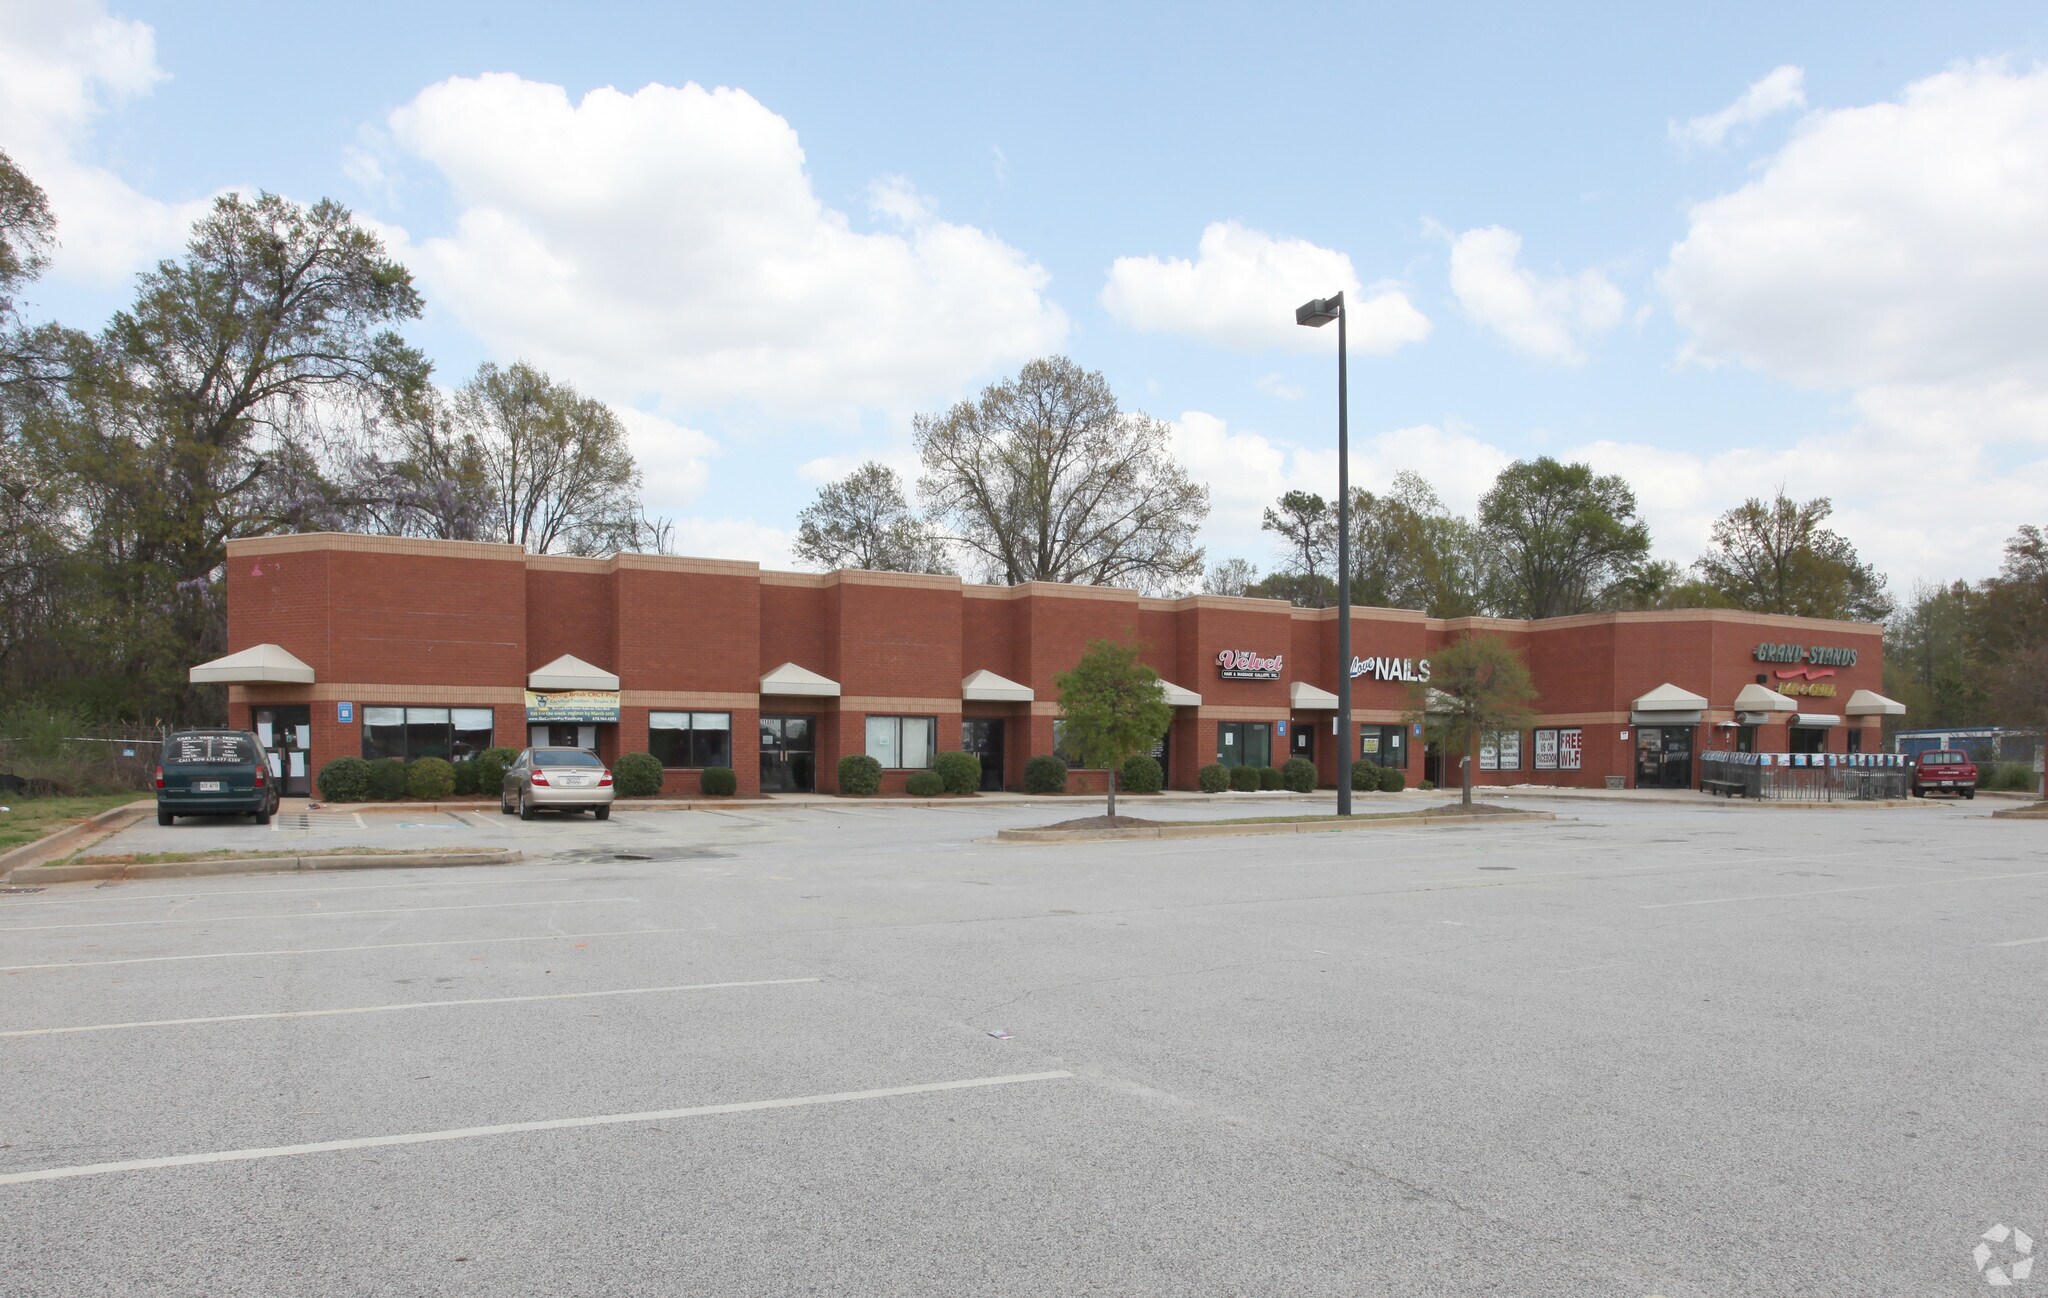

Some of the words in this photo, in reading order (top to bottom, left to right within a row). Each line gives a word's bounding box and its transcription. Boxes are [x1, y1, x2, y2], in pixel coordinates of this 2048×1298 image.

[1218, 649, 1283, 671] Velvet
[1757, 643, 1804, 663] GRAND
[1809, 646, 1858, 667] STANDS
[1350, 656, 1375, 678] Love
[1375, 656, 1431, 682] NAILS
[1539, 731, 1555, 741] FOLLOW
[1560, 733, 1582, 749] FREE
[1540, 742, 1547, 752] US
[1547, 742, 1554, 752] ON
[1536, 753, 1558, 763] FACEBOOK
